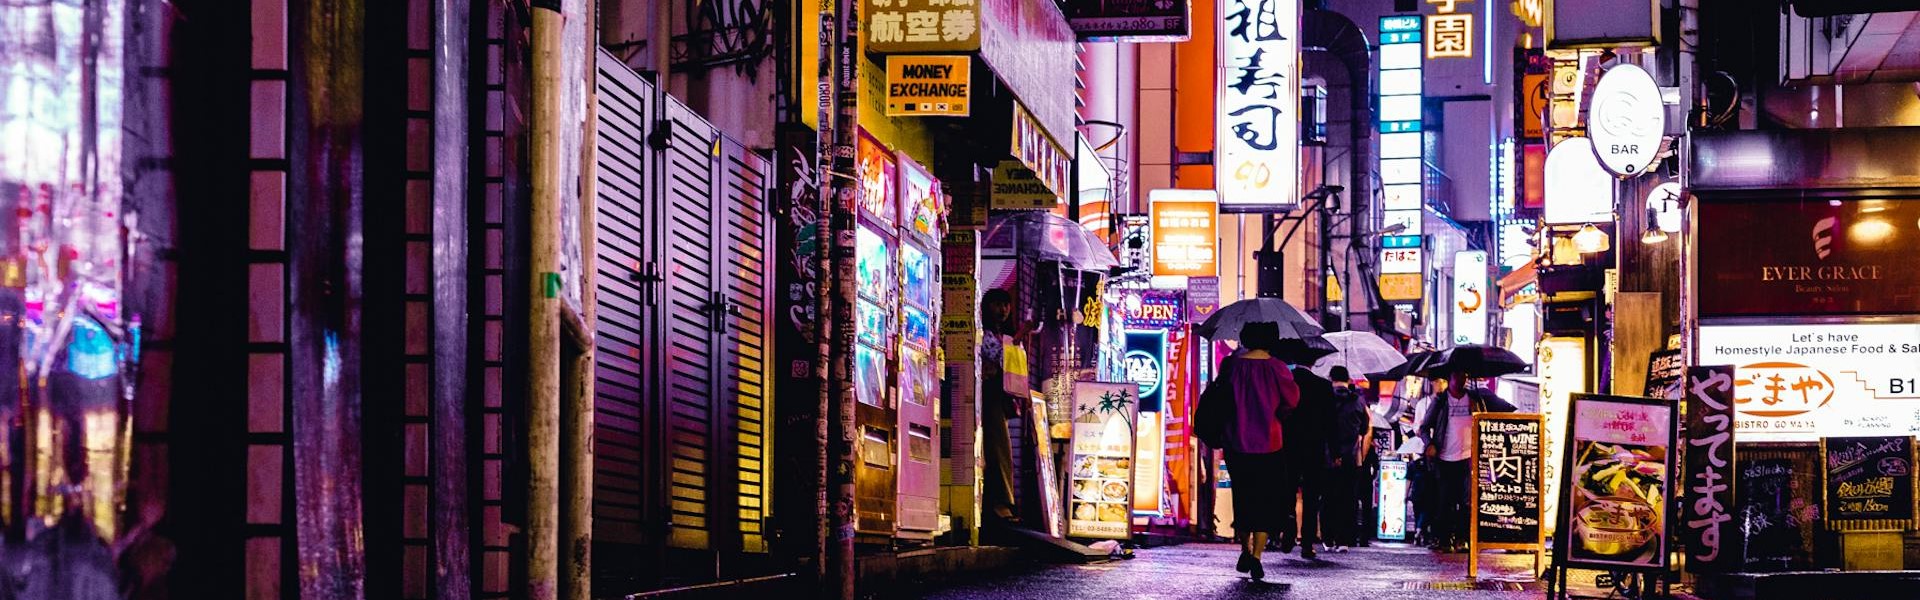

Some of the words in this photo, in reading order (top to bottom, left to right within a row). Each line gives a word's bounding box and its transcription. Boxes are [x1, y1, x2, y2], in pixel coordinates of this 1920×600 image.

[870, 9, 977, 43] 航空券
[902, 64, 953, 79] MONEY
[890, 83, 967, 98] EXCHANGE
[1611, 144, 1639, 155] BAR
[1762, 265, 1813, 281] EVER
[1817, 265, 1883, 280] GRACE
[1131, 304, 1174, 320] OPEN
[1828, 332, 1859, 342] have
[1715, 345, 1782, 356] Homestyle
[1786, 344, 1847, 355] Japanese
[1851, 343, 1884, 353] Food
[1888, 343, 1896, 353] &
[1735, 372, 1824, 406] ごまや
[1889, 378, 1916, 394] B1
[1735, 420, 1769, 429] BISTRO
[1509, 432, 1539, 446] WINE
[1488, 446, 1522, 483] 肉
[1687, 368, 1734, 562] やってます
[1490, 483, 1522, 494] ビストロ
